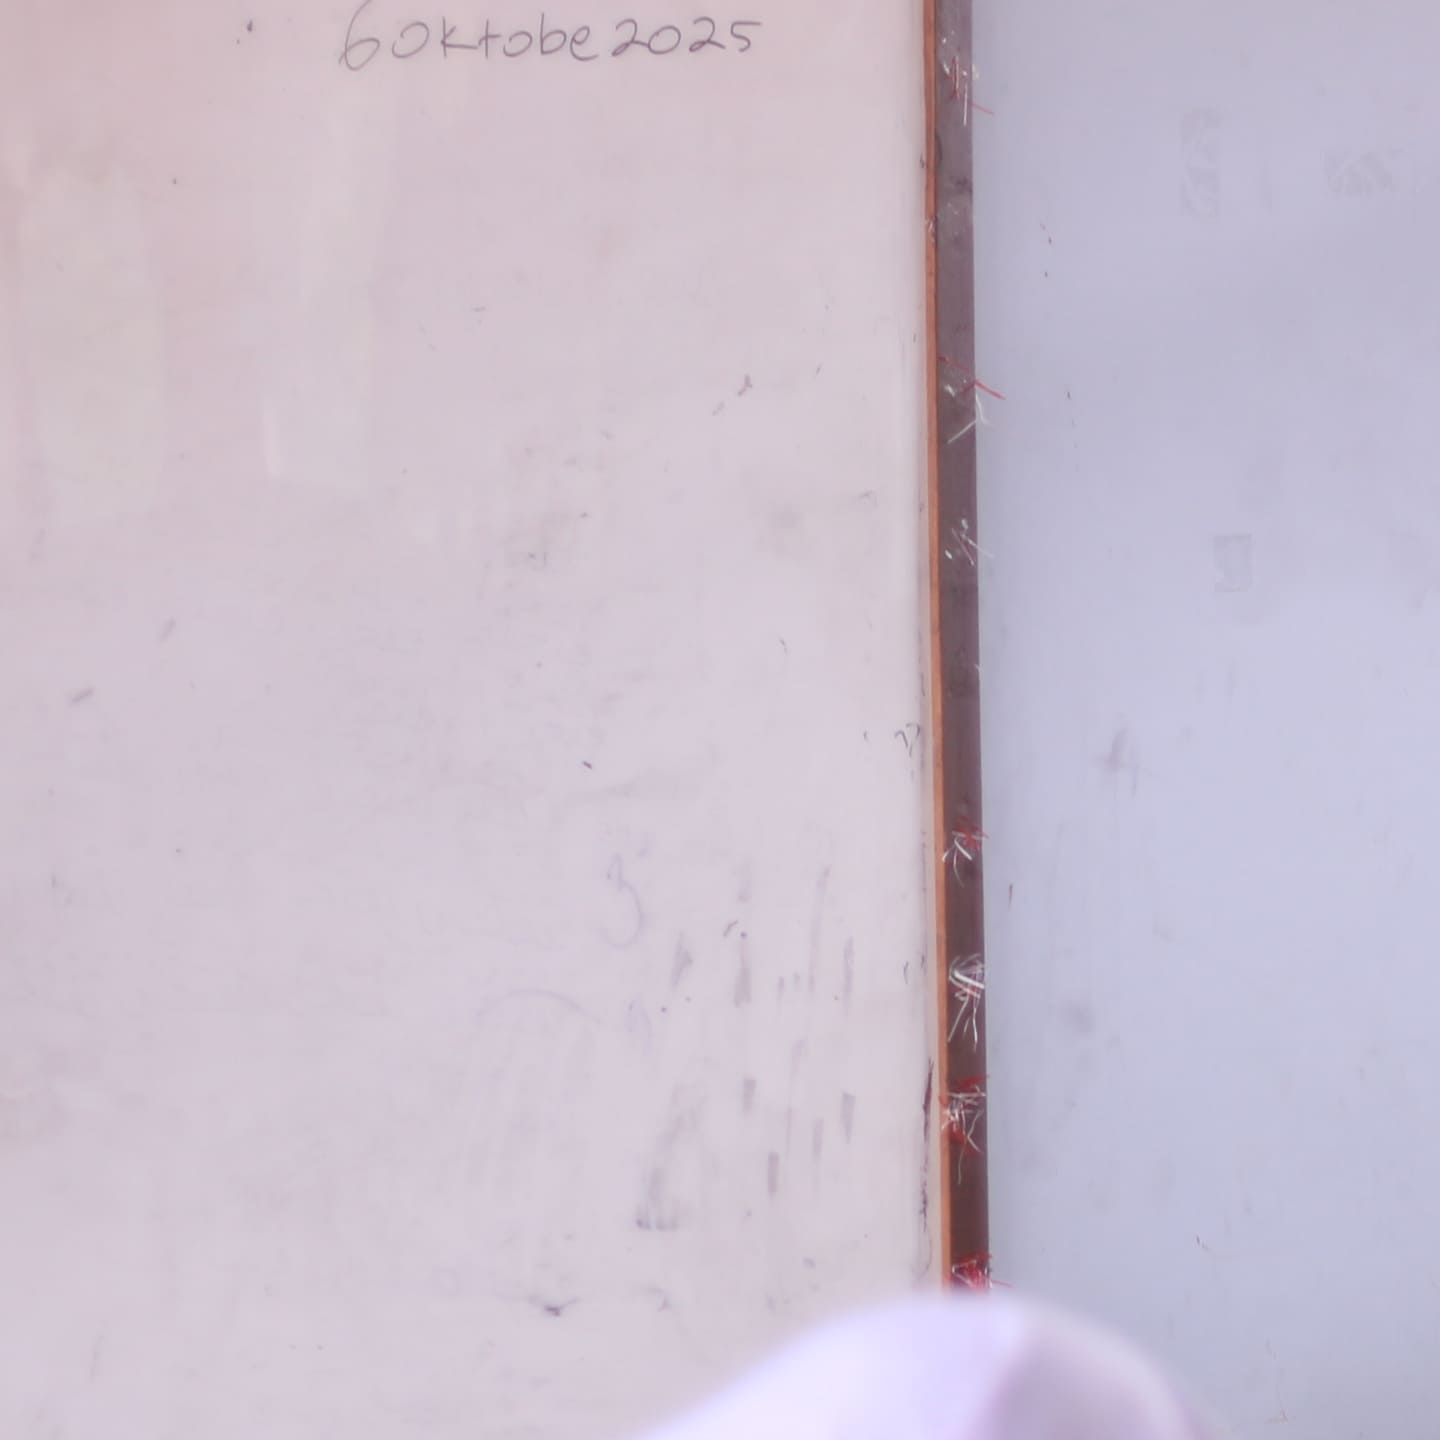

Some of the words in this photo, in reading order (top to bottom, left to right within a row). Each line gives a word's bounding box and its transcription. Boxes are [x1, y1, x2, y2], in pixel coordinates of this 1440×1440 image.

[339, 0, 381, 71] 6
[391, 13, 598, 62] Oktobe
[611, 16, 762, 57] 2025
